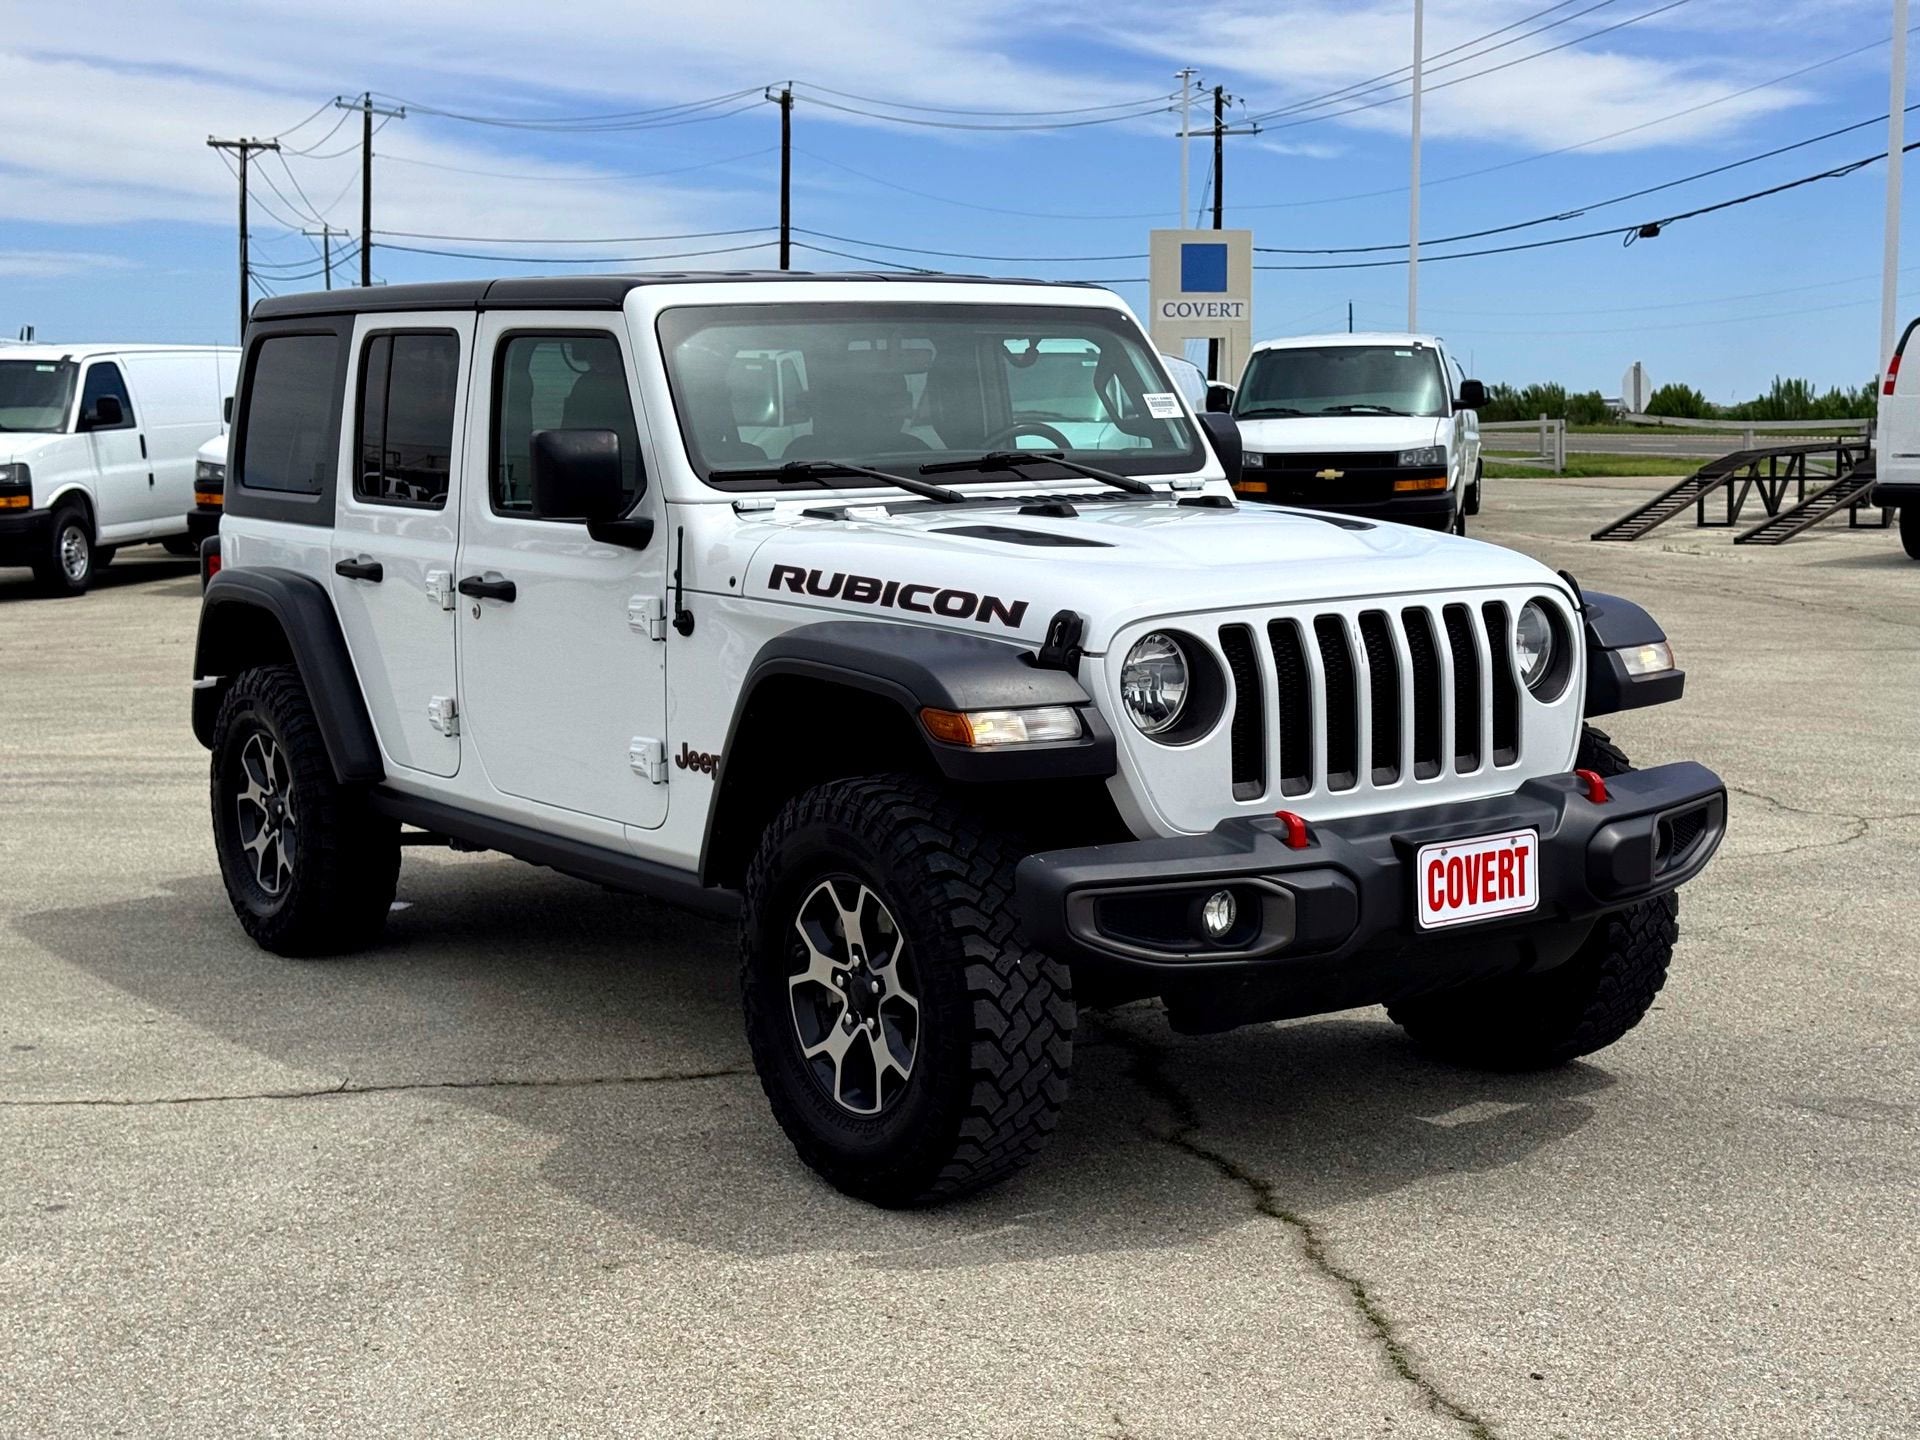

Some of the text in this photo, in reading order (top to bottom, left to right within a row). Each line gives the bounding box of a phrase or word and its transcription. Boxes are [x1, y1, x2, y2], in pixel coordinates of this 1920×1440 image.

[1163, 302, 1243, 318] COVERT
[767, 564, 1029, 629] RUBICON
[675, 742, 721, 781] Jeep
[1427, 846, 1529, 912] COVERT
